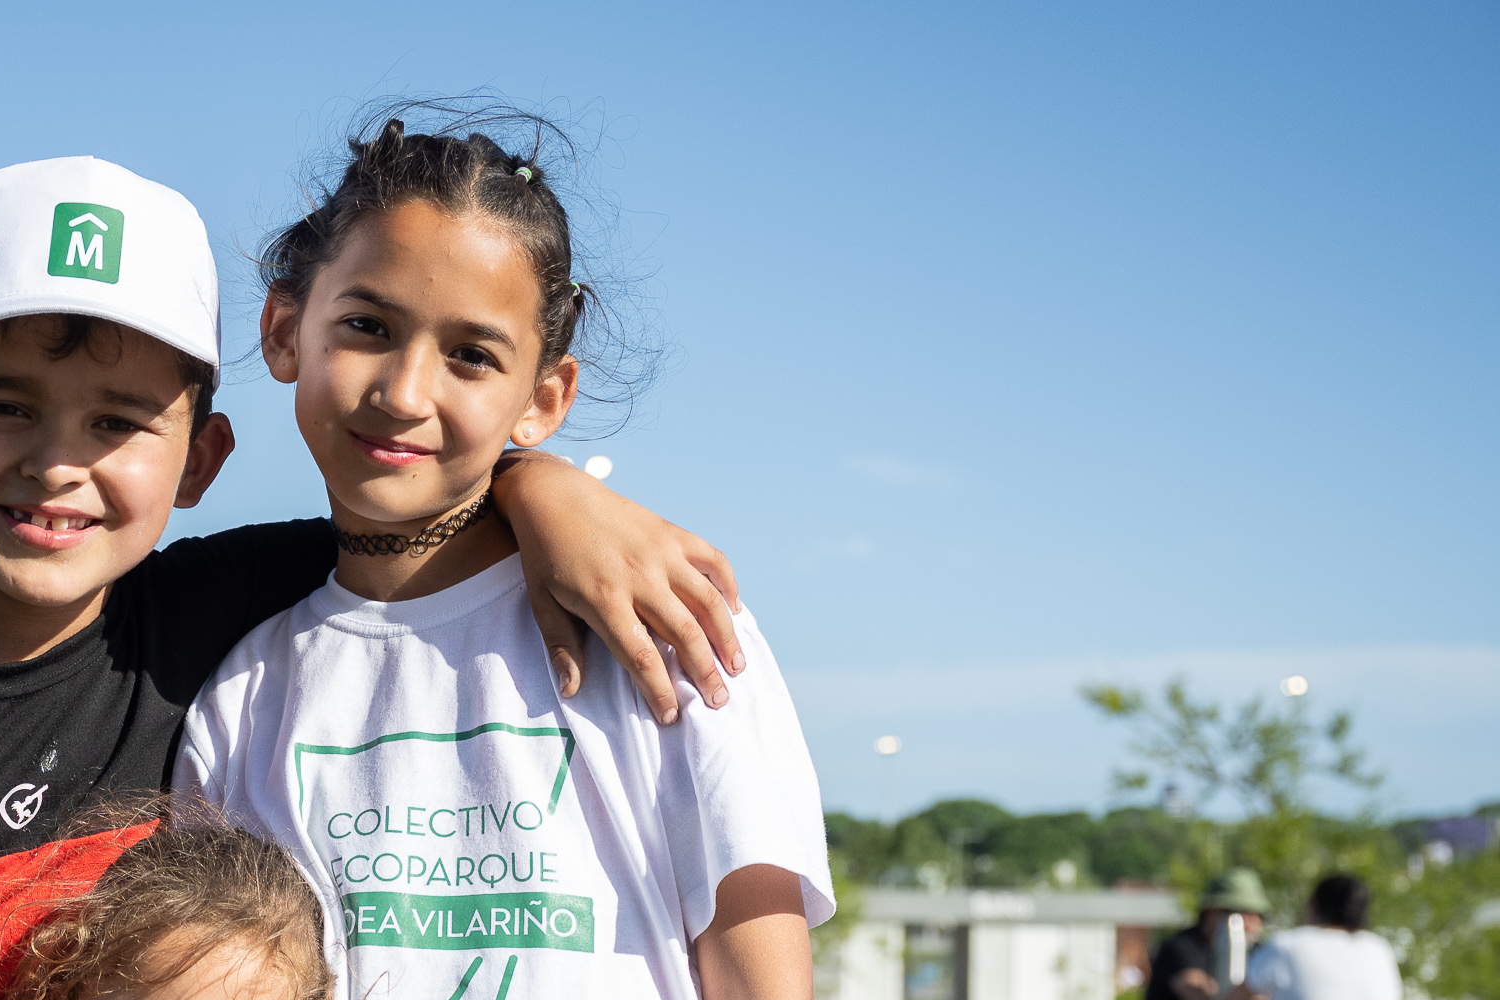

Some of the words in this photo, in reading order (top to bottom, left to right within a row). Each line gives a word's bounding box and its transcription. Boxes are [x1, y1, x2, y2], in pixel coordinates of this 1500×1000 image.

[65, 230, 104, 270] M
[328, 801, 542, 839] COLECTIVO
[330, 852, 559, 889] ECOPARQUE
[412, 900, 578, 939] VILARIÑO
